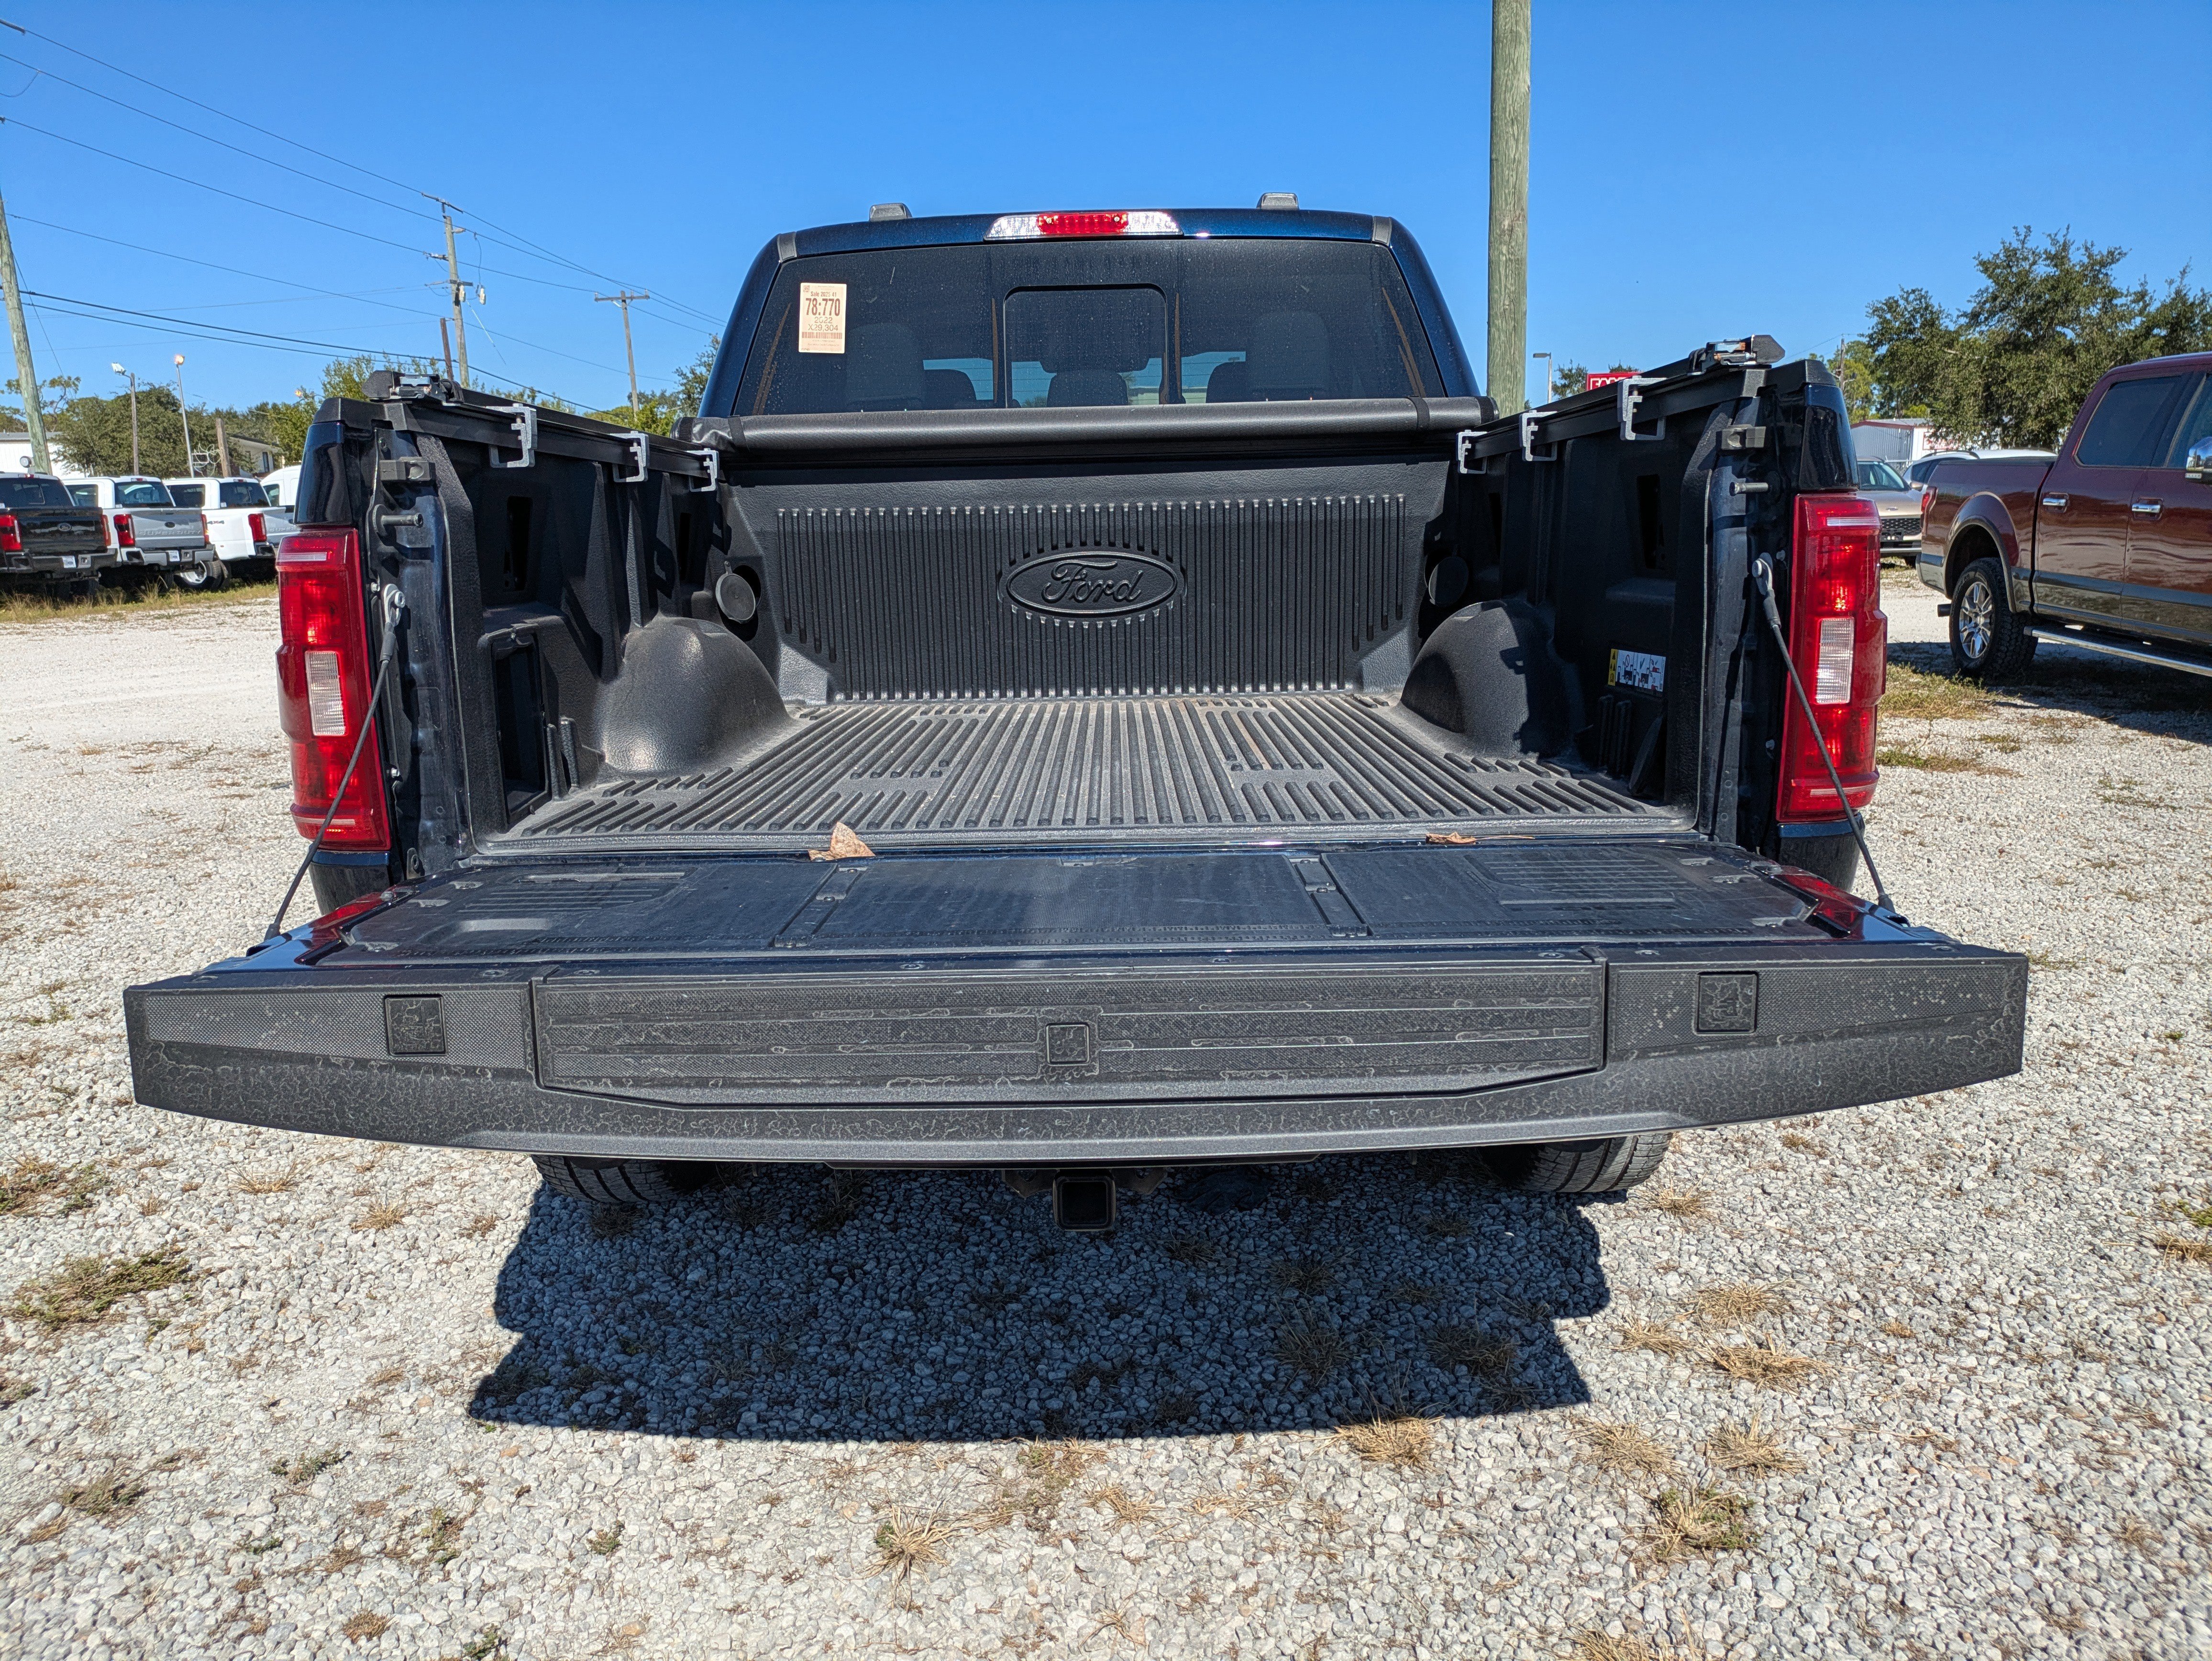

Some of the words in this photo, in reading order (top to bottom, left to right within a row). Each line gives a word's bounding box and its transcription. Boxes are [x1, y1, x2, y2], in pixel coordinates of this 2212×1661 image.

[806, 298, 841, 316] 78:770
[808, 323, 838, 332] X29,304
[1041, 560, 1144, 604] Ford
